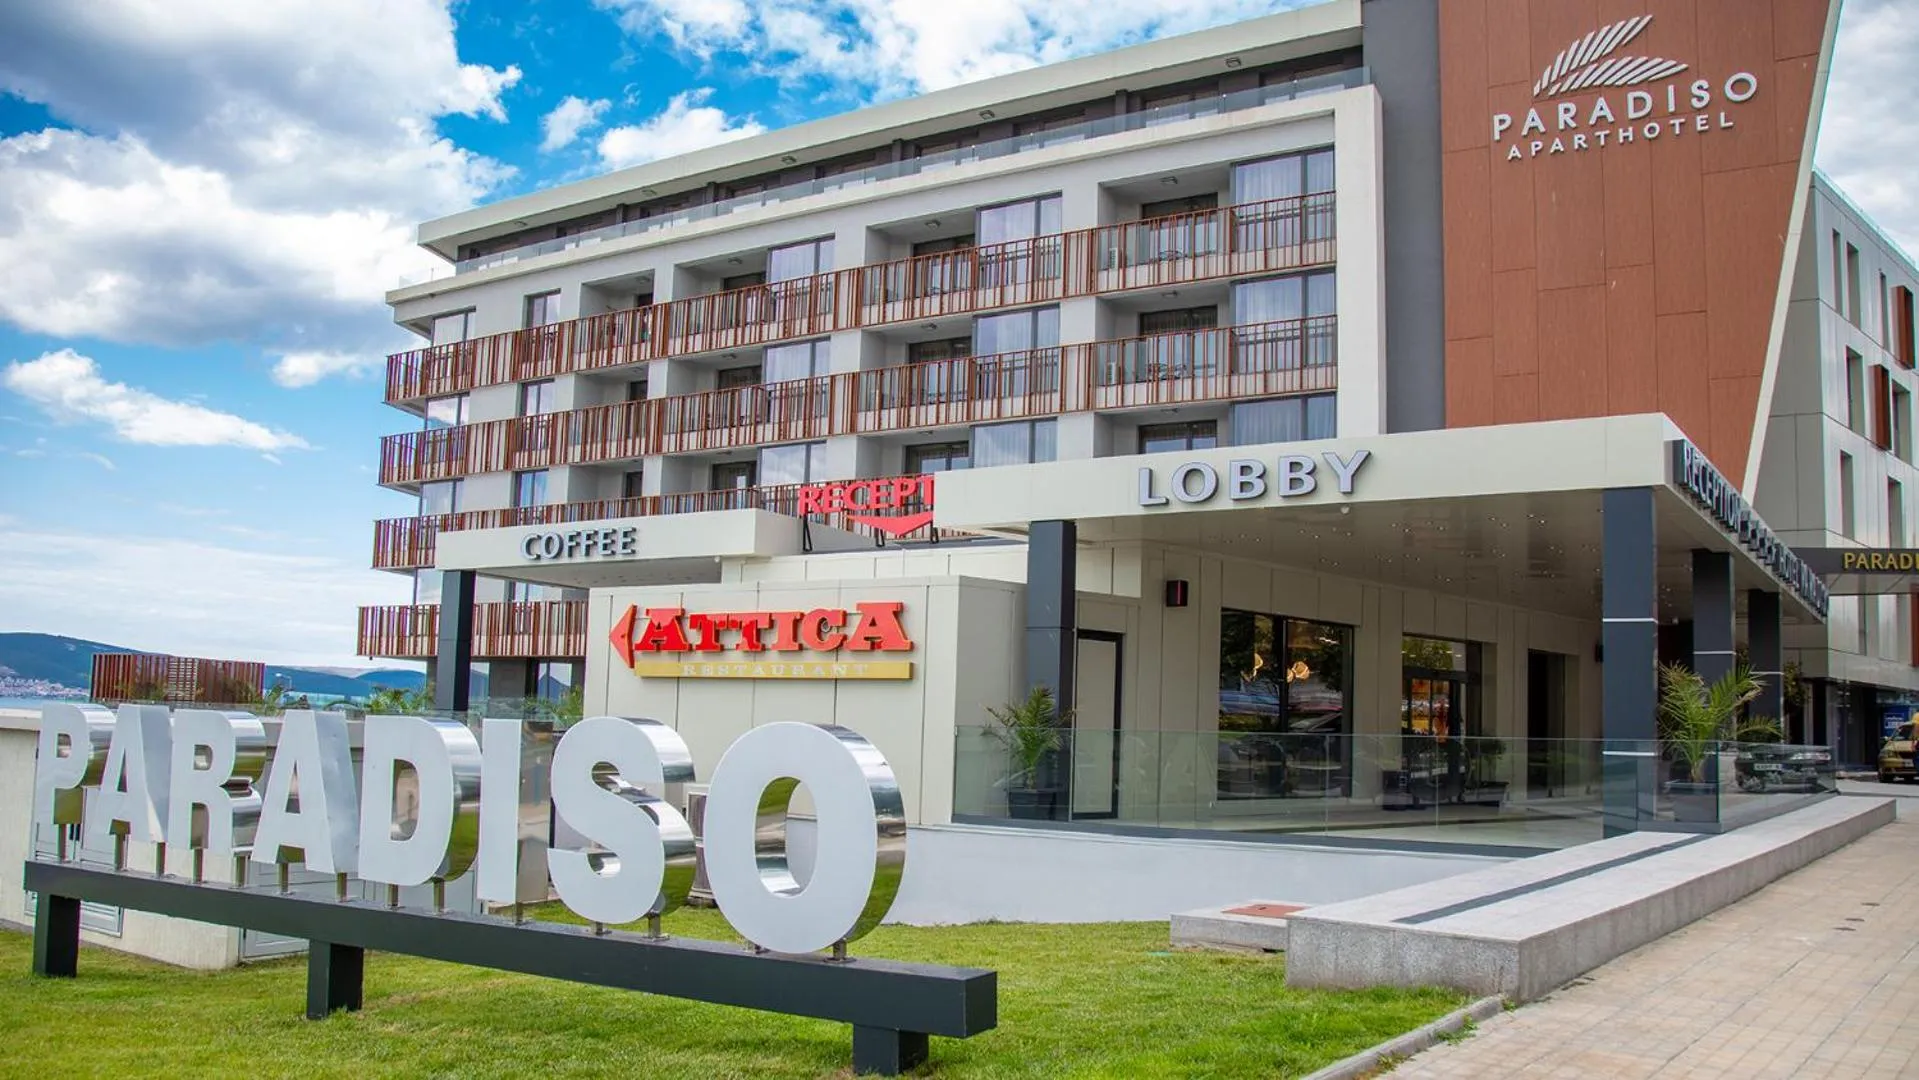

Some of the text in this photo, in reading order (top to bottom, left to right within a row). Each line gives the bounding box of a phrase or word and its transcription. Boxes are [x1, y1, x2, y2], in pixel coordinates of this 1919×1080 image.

[1493, 72, 1758, 141] PARADISO
[1507, 111, 1734, 161] APARTHOTEL
[1138, 450, 1372, 507] LOBBY
[1684, 441, 1741, 532] RECEPTION
[521, 527, 637, 560] COFFEE
[634, 602, 913, 652] ATTICA
[682, 664, 870, 678] RESTAURANT
[37, 701, 906, 954] PARADISO
